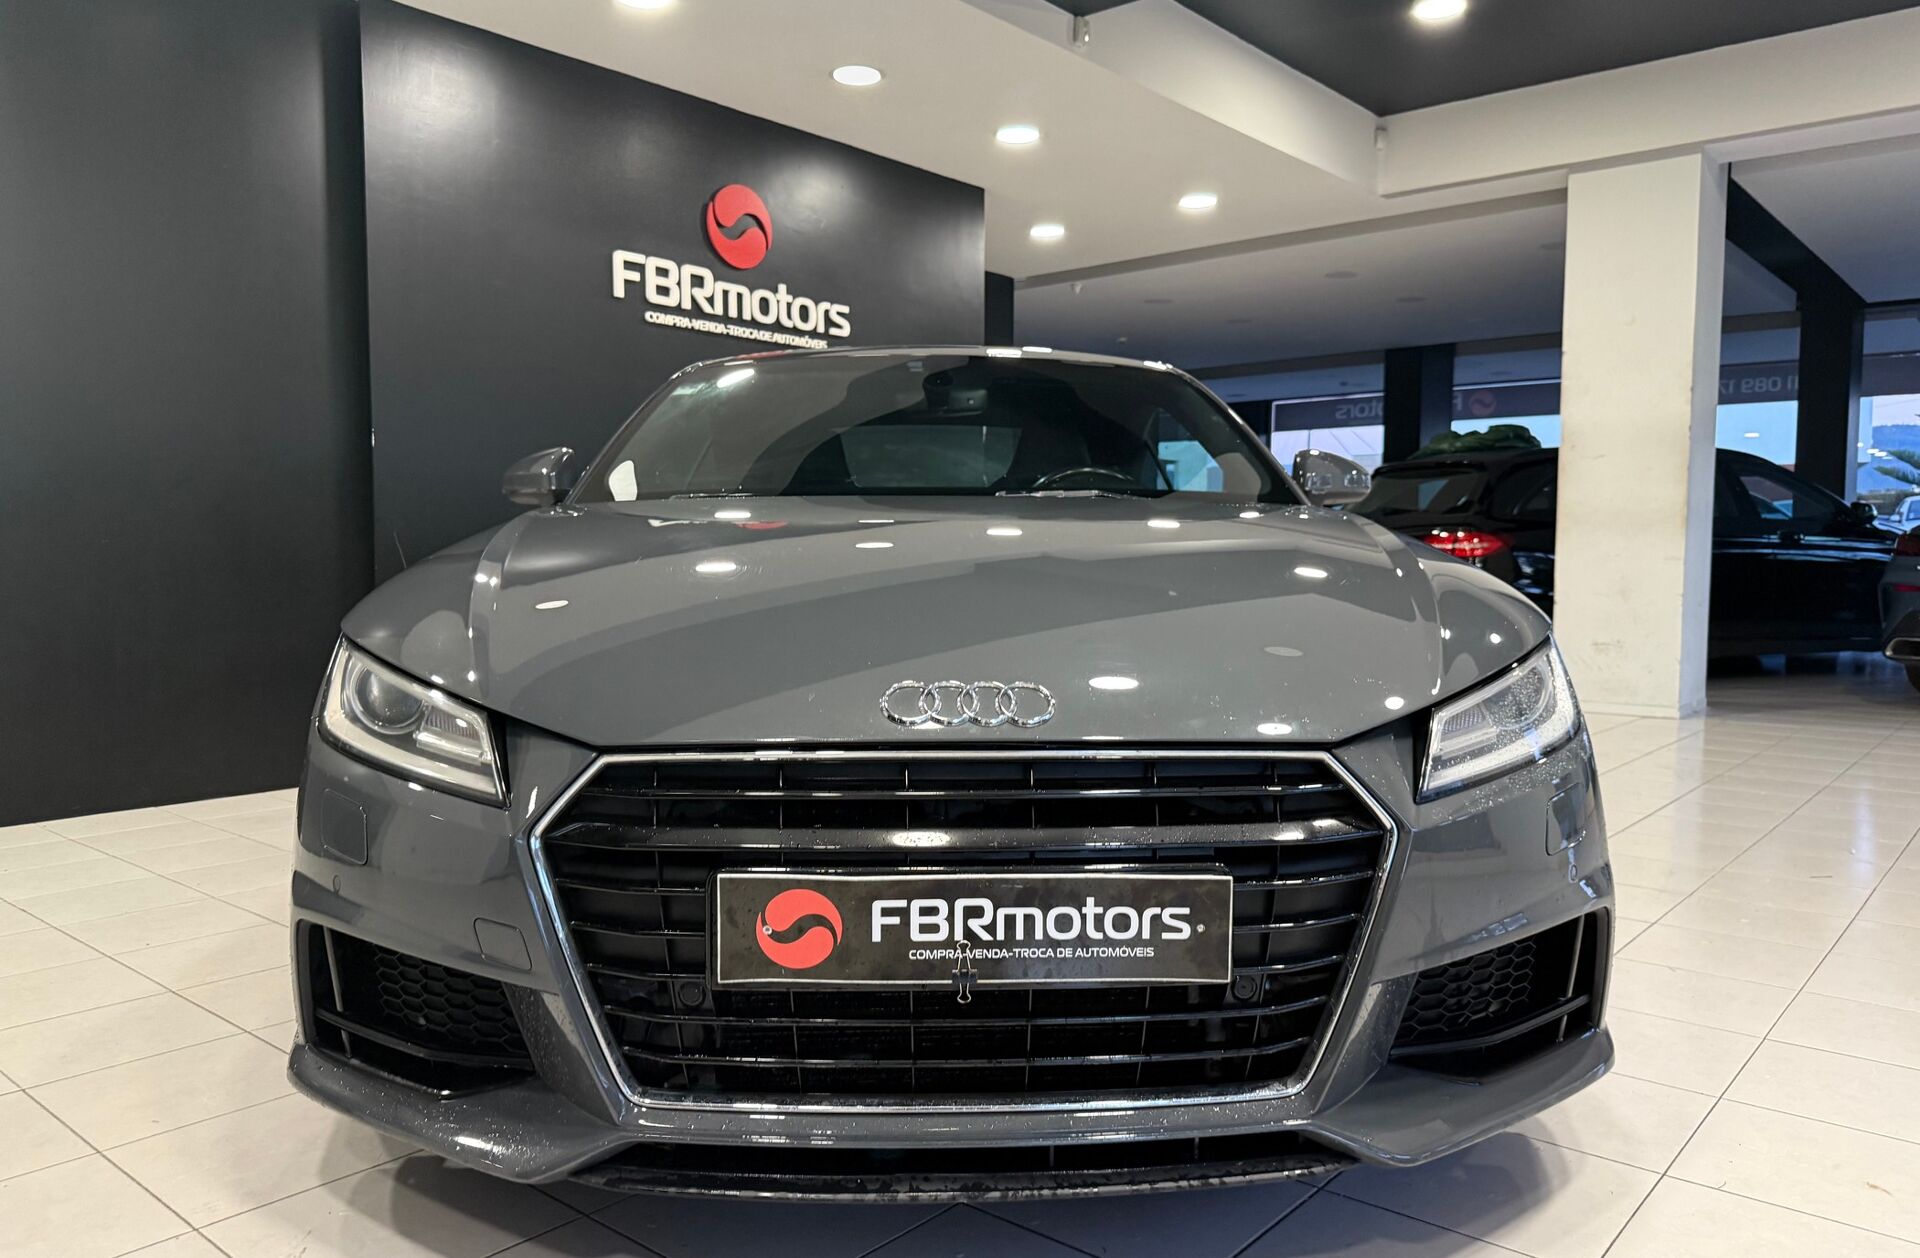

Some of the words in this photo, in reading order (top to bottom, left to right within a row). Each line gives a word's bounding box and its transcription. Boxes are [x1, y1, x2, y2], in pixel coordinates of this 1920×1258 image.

[612, 249, 850, 337] FBRmotors
[872, 896, 1191, 942] FBRmotors
[1056, 948, 1073, 959] DE
[1075, 945, 1155, 959] AUTOMÓVEIS
